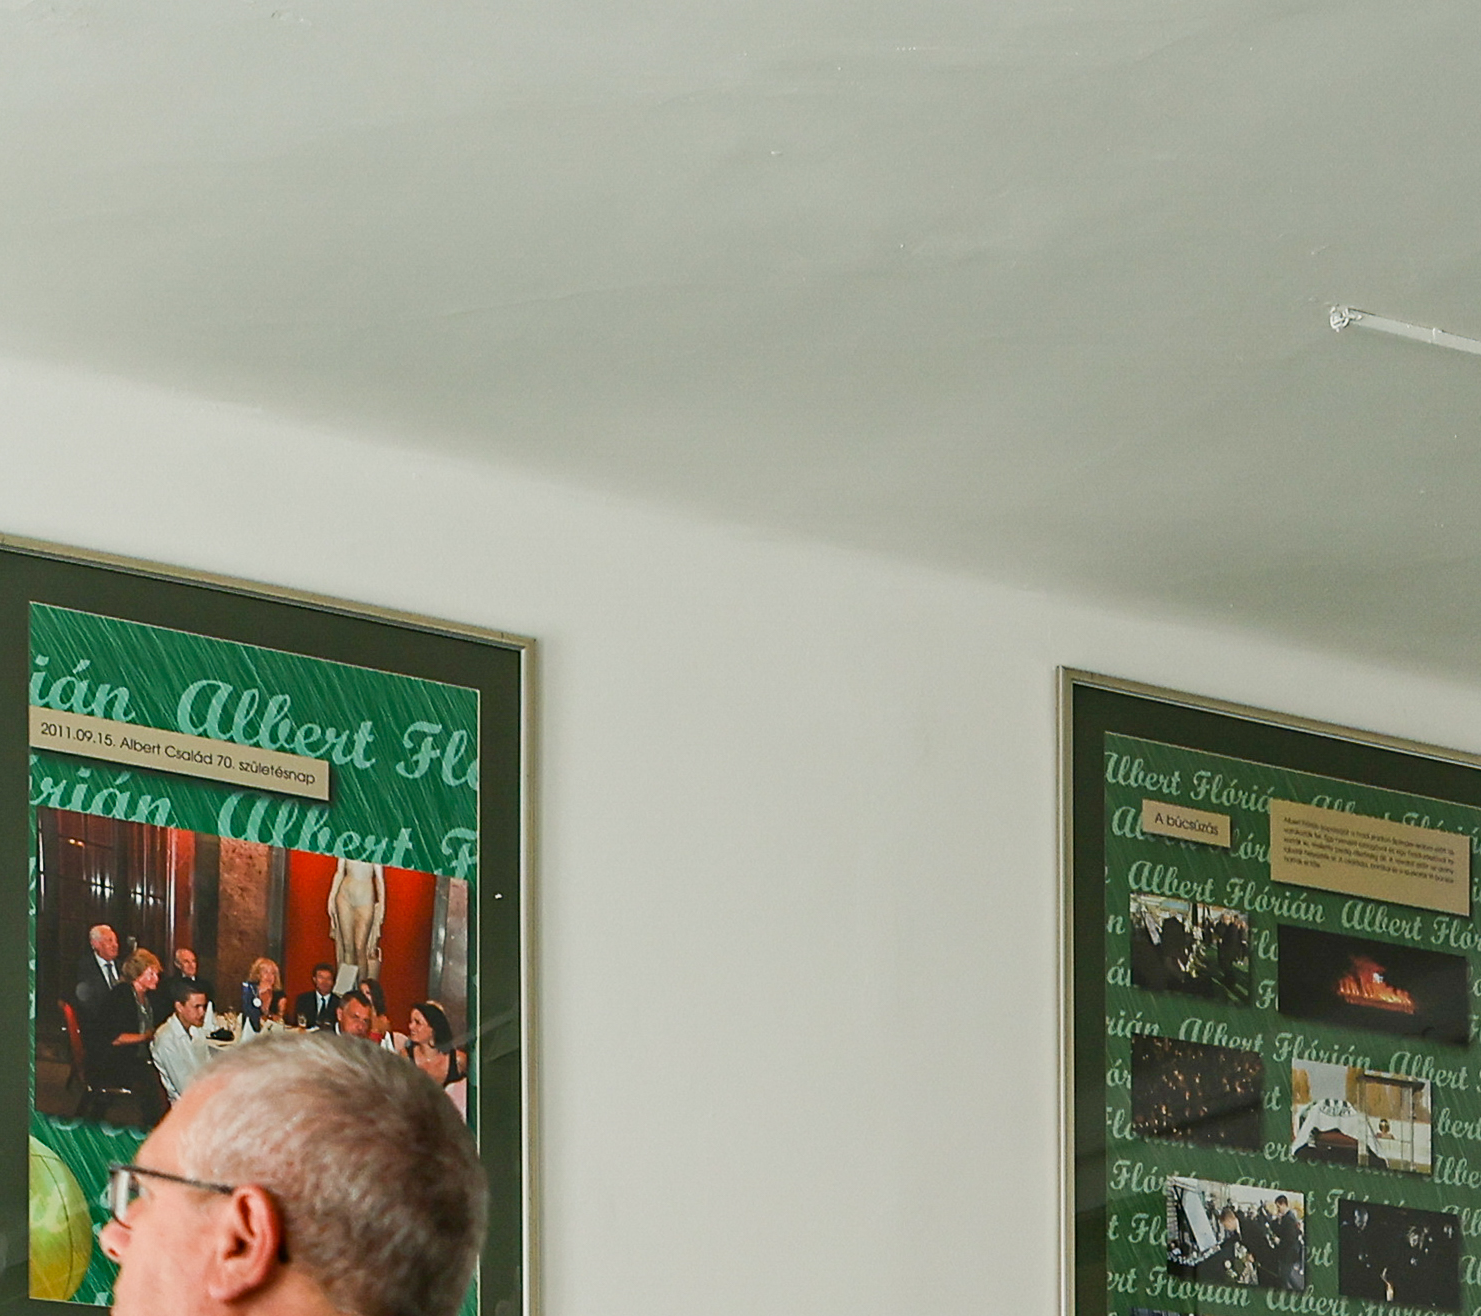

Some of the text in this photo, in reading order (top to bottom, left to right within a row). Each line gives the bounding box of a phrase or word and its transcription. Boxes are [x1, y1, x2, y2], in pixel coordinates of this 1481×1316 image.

[176, 678, 377, 770] Albert
[40, 720, 317, 787] 2011.09.15. Albert Család 70. születésnap
[1105, 751, 1181, 796] Albert
[1154, 812, 1219, 837] A búcsúzás
[1128, 859, 1216, 902] Albert
[1224, 876, 1325, 923] Flórián
[1341, 899, 1423, 941] Albert
[1388, 1051, 1480, 1093] Albert
